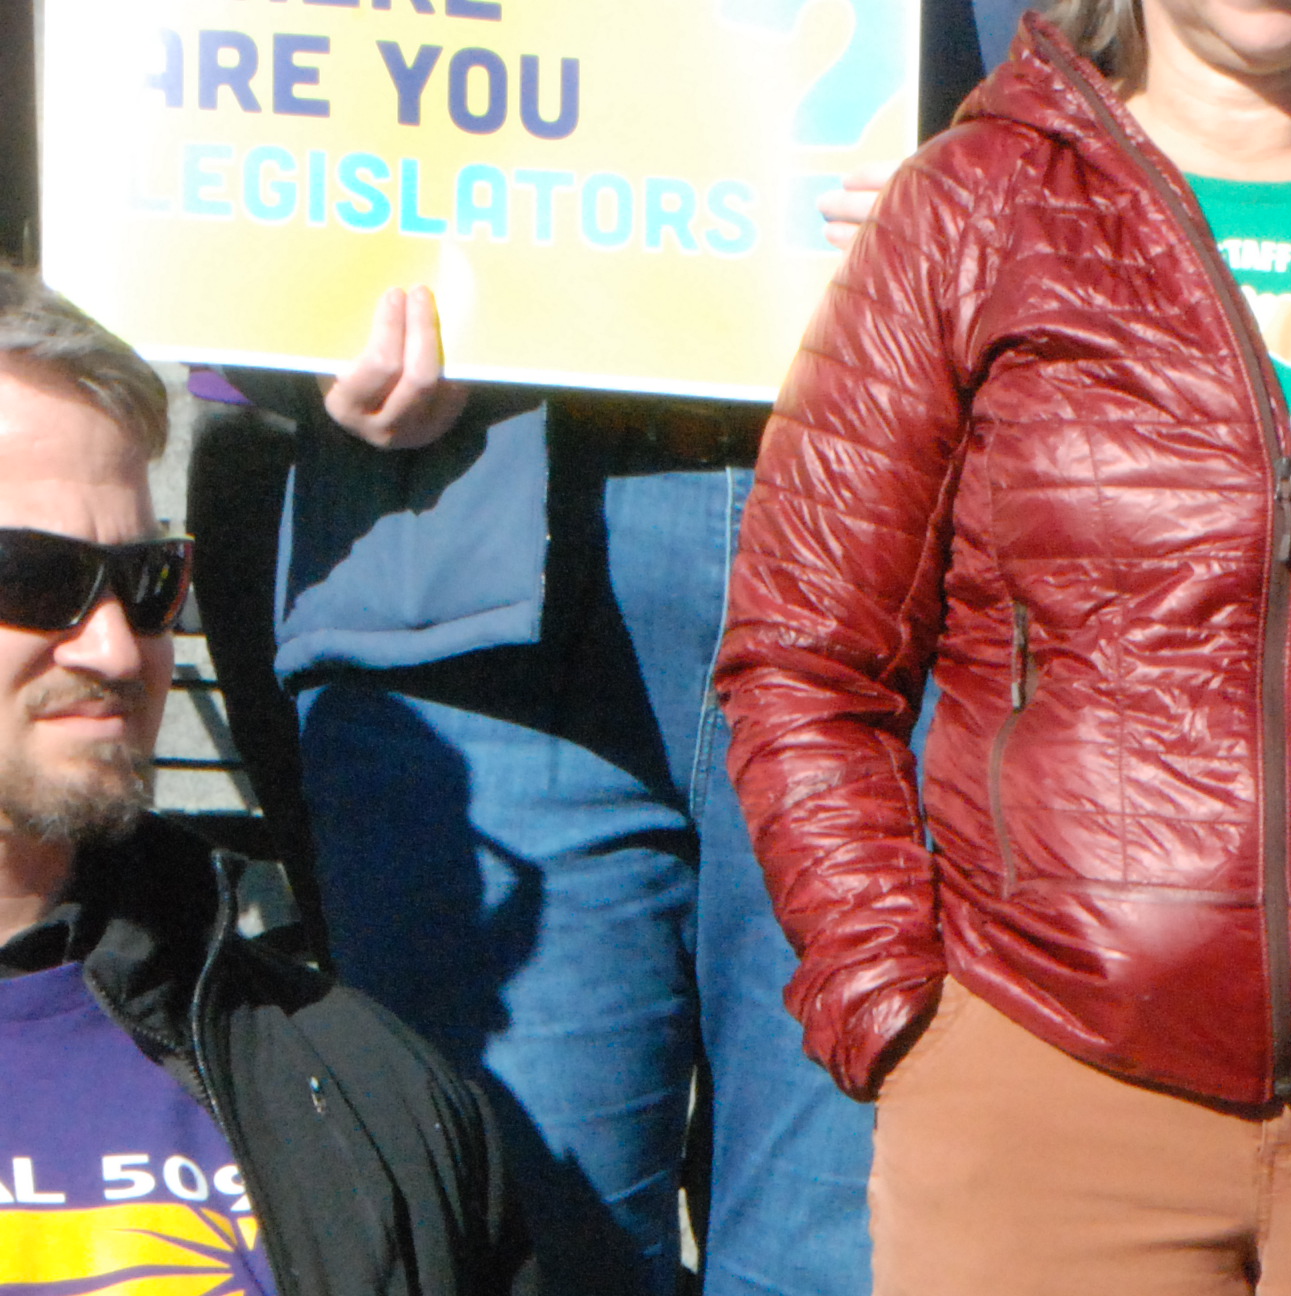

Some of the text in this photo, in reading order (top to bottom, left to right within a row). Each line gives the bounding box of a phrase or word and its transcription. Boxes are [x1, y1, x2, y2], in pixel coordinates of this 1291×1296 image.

[376, 39, 580, 140] YOU
[127, 143, 758, 254] LEGISLATORS
[0, 1157, 66, 1204] L
